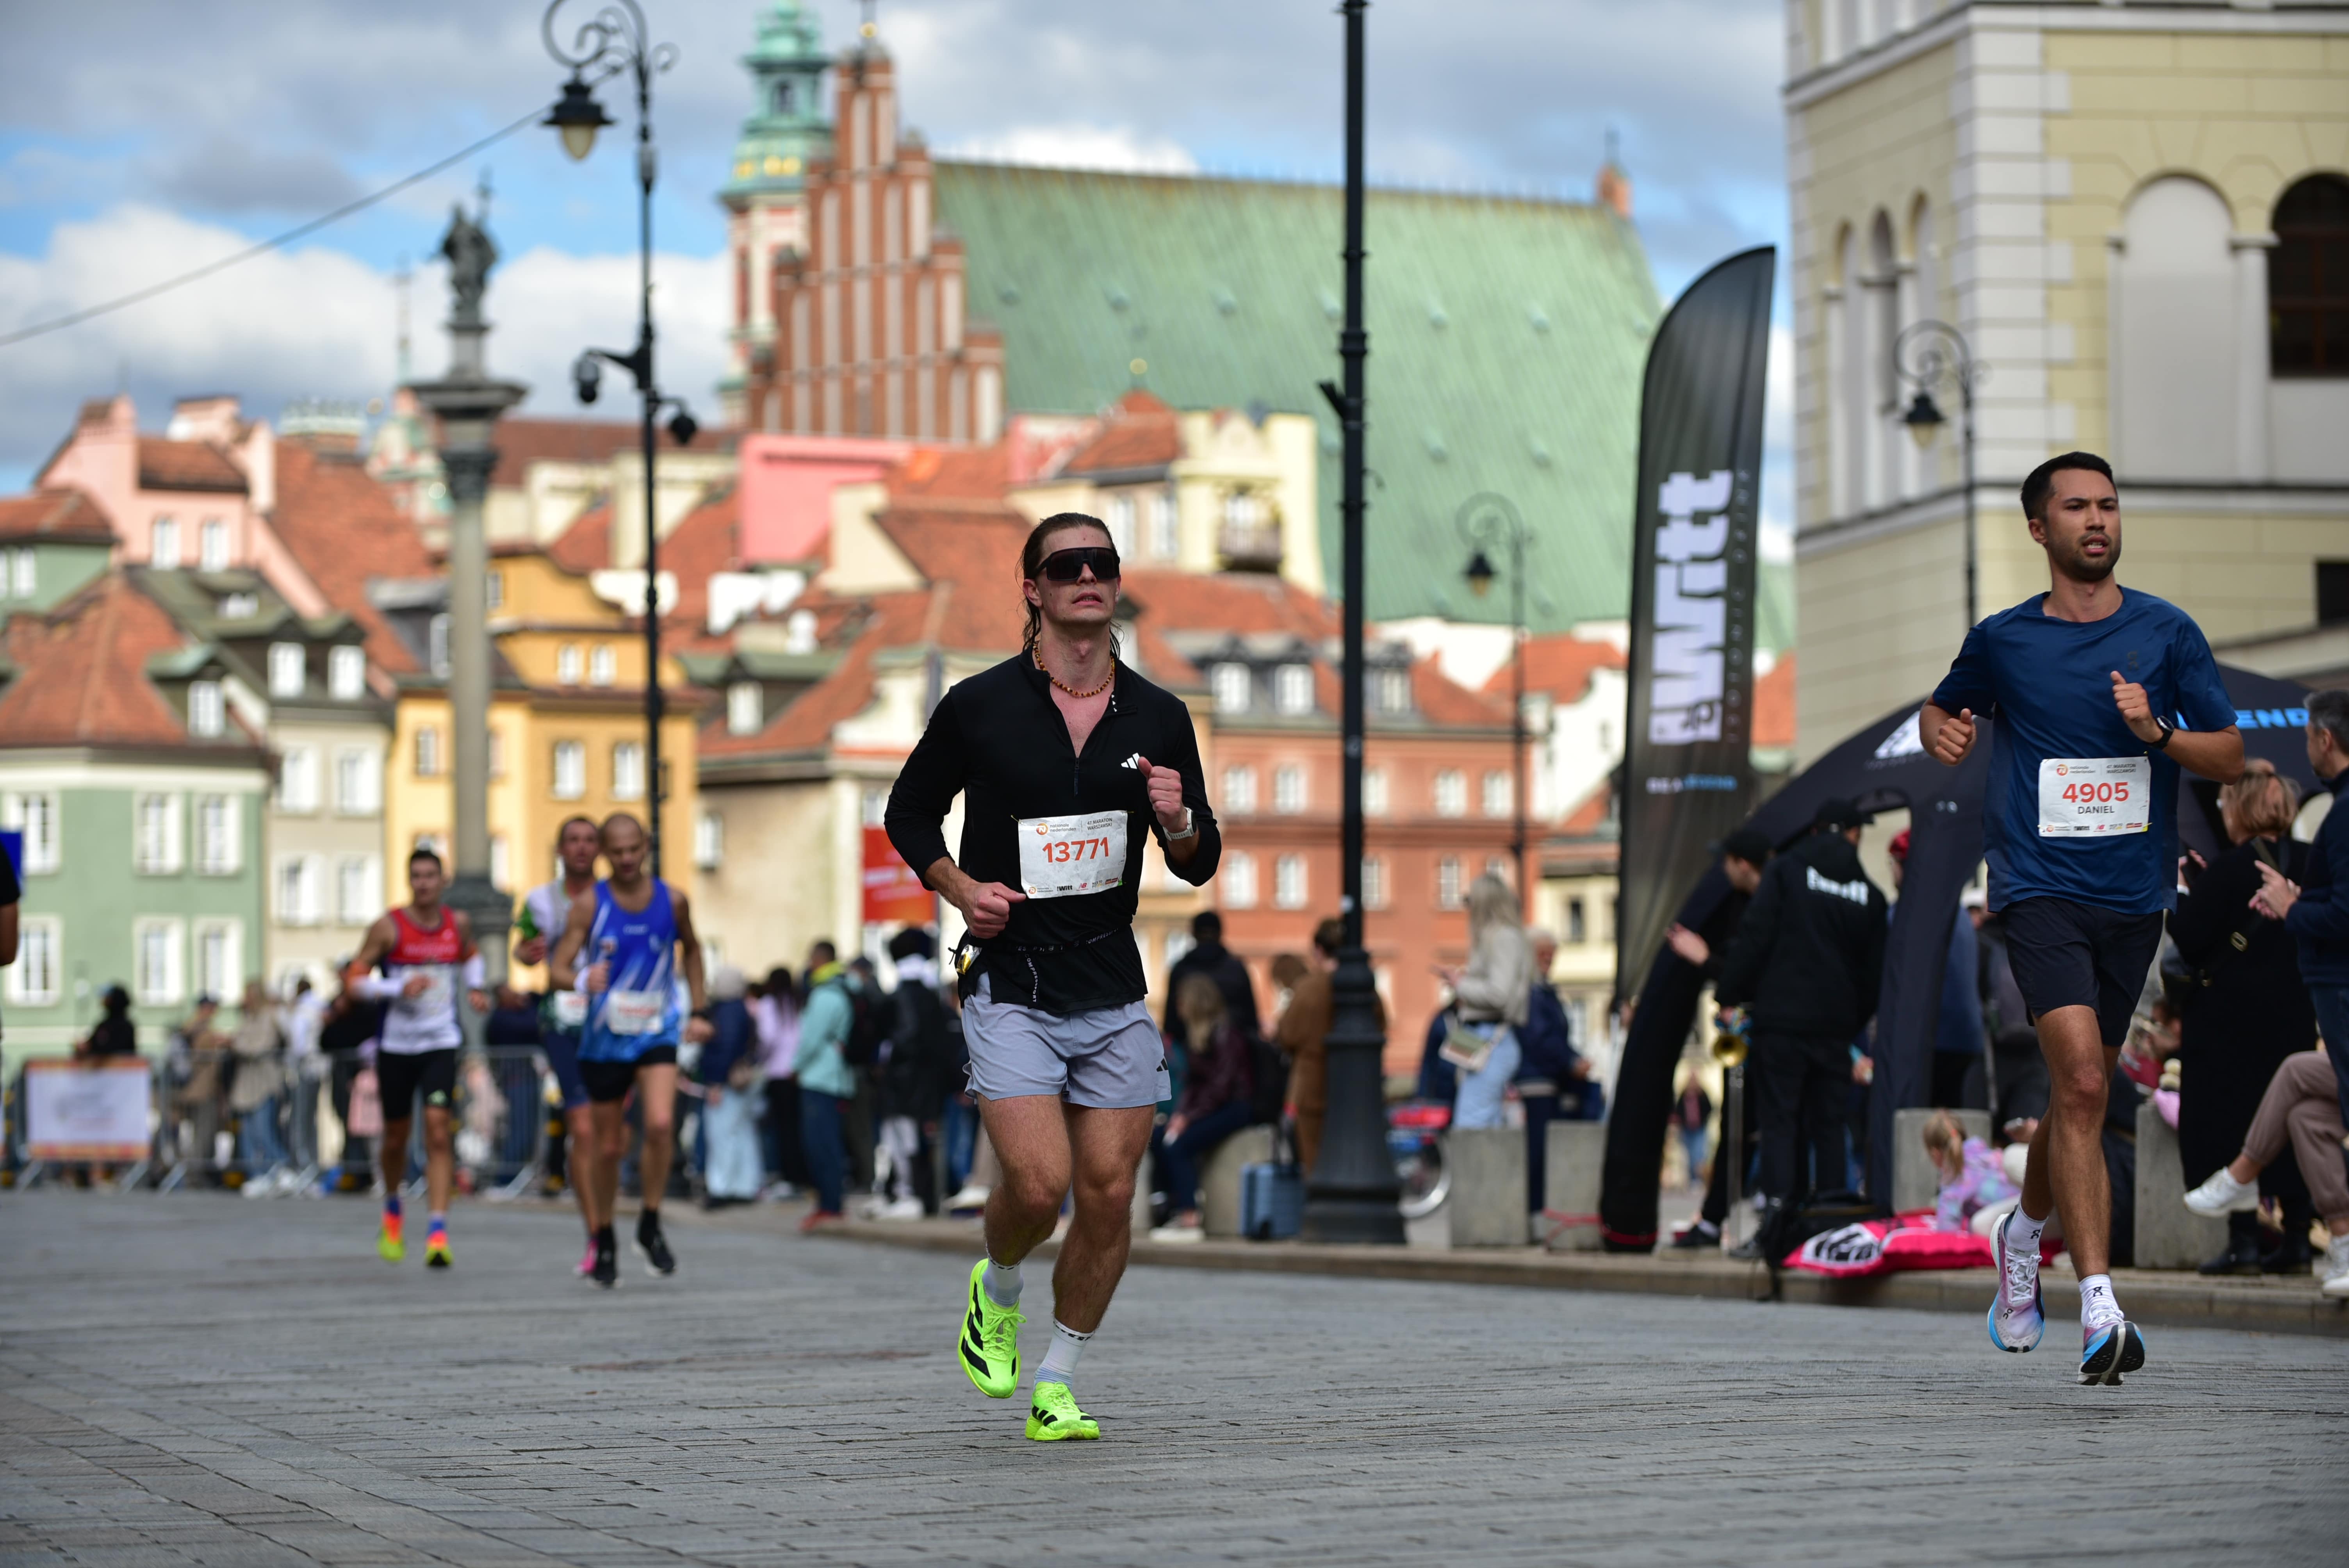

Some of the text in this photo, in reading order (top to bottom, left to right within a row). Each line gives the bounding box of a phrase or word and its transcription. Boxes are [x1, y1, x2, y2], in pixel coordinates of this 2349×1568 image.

[2062, 782, 2130, 803] 4905
[2077, 805, 2115, 814] DANIEL
[1042, 837, 1109, 863] 13771
